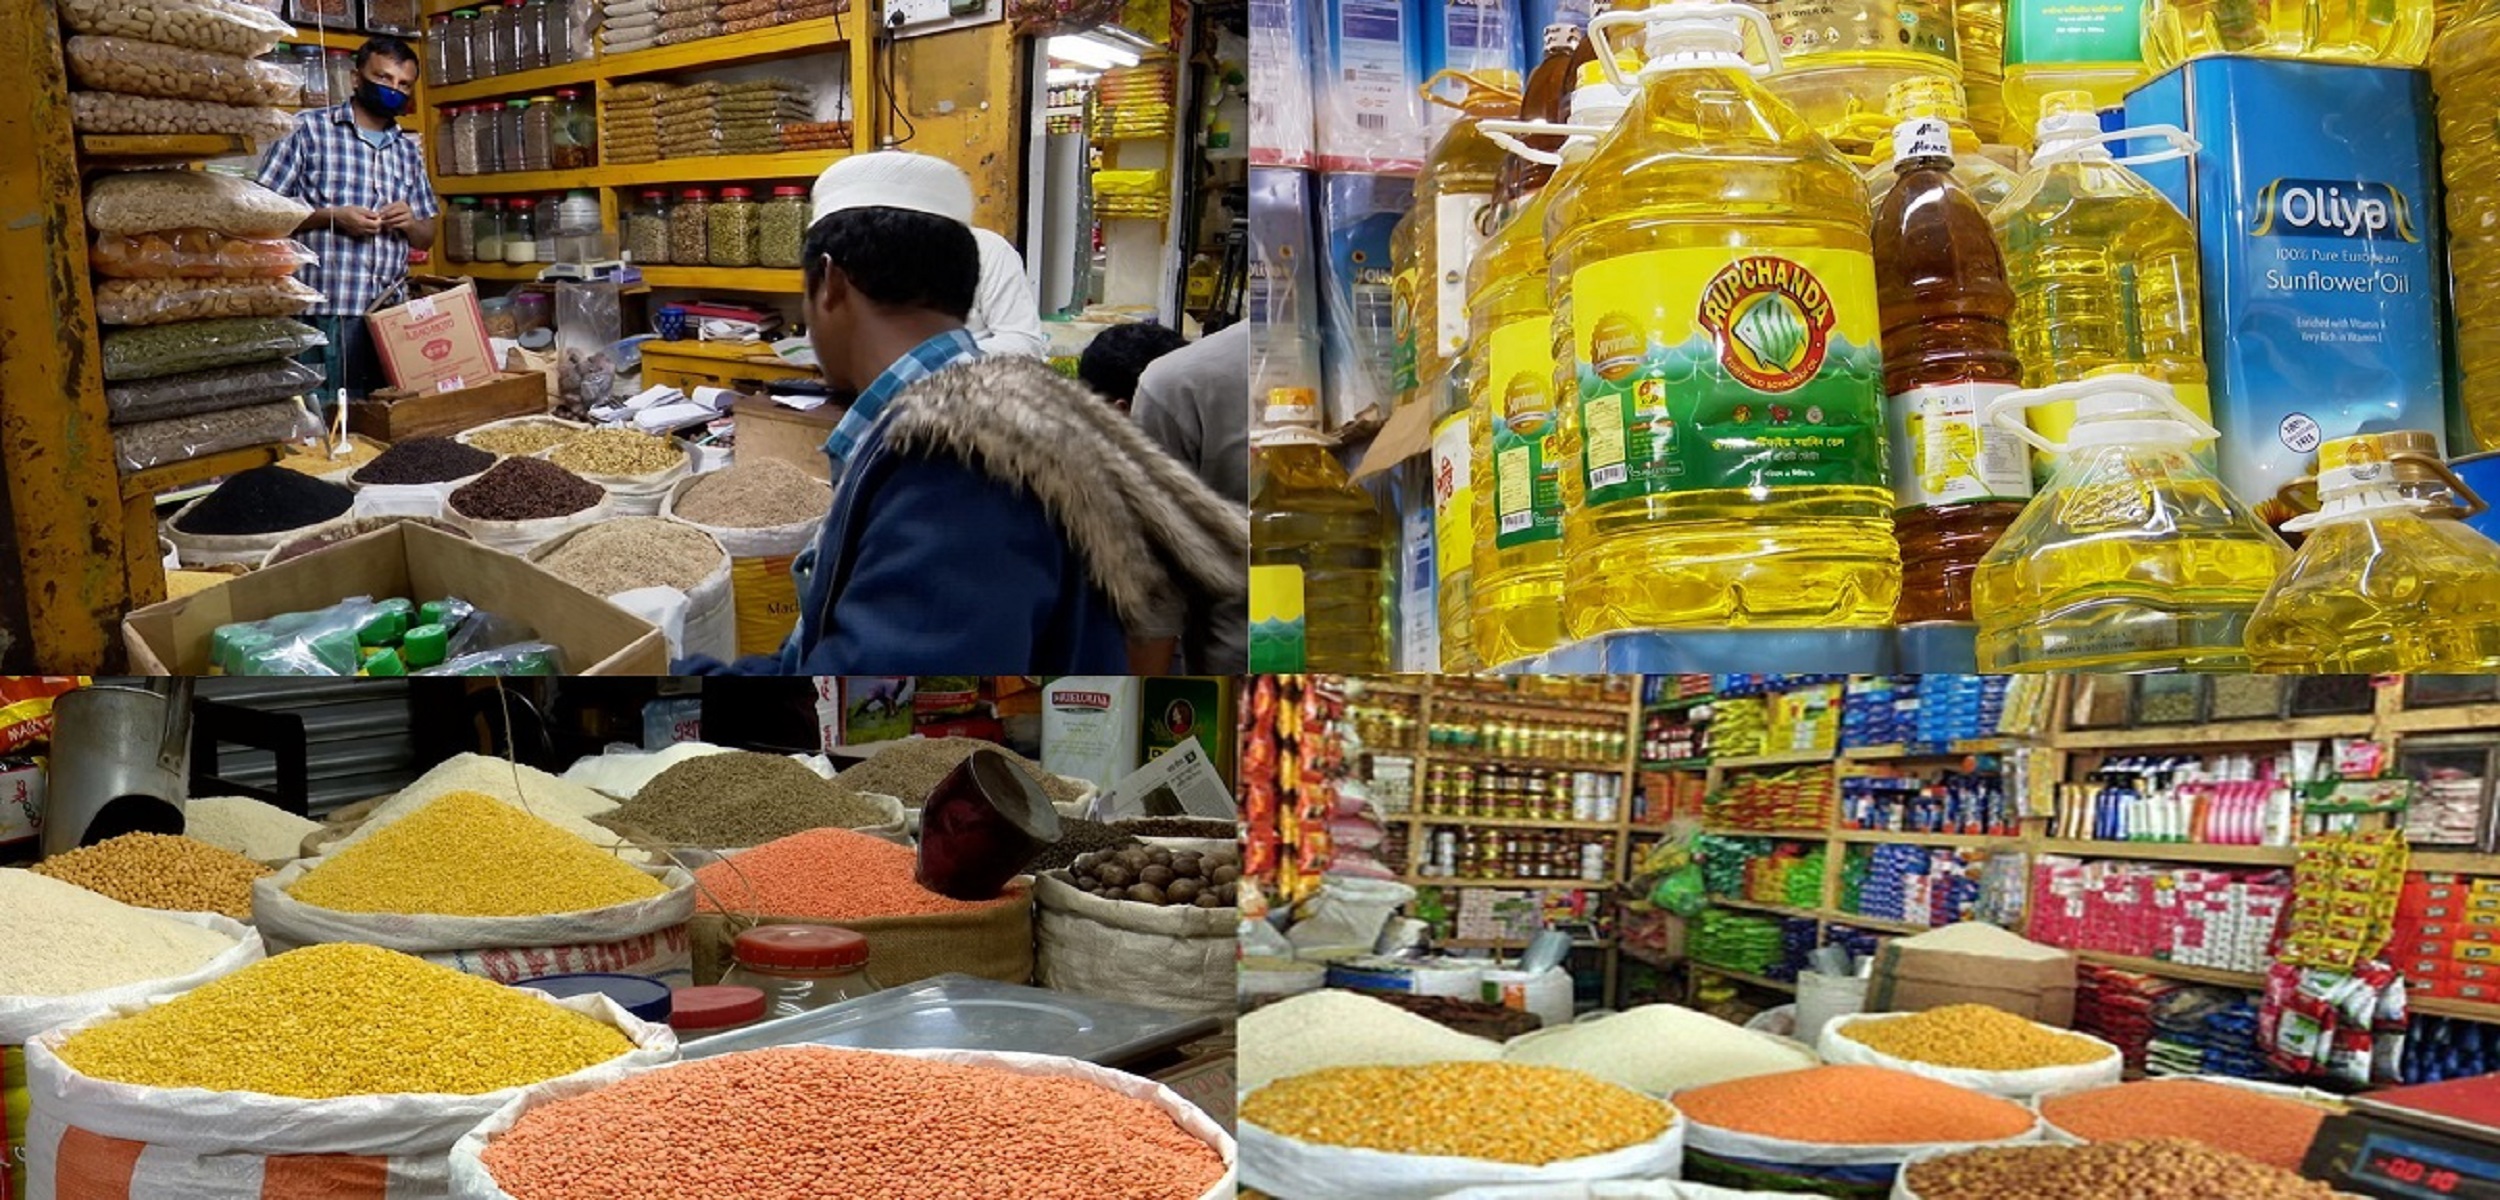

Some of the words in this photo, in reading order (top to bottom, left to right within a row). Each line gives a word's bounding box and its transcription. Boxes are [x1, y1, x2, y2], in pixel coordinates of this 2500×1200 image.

[2281, 186, 2388, 237] Oliya
[2275, 248, 2309, 261] 100%
[2311, 249, 2339, 262] Pure
[1704, 259, 1830, 330] RUPCHANDA
[2266, 269, 2374, 294] Sunflower
[2379, 273, 2410, 294] Oil
